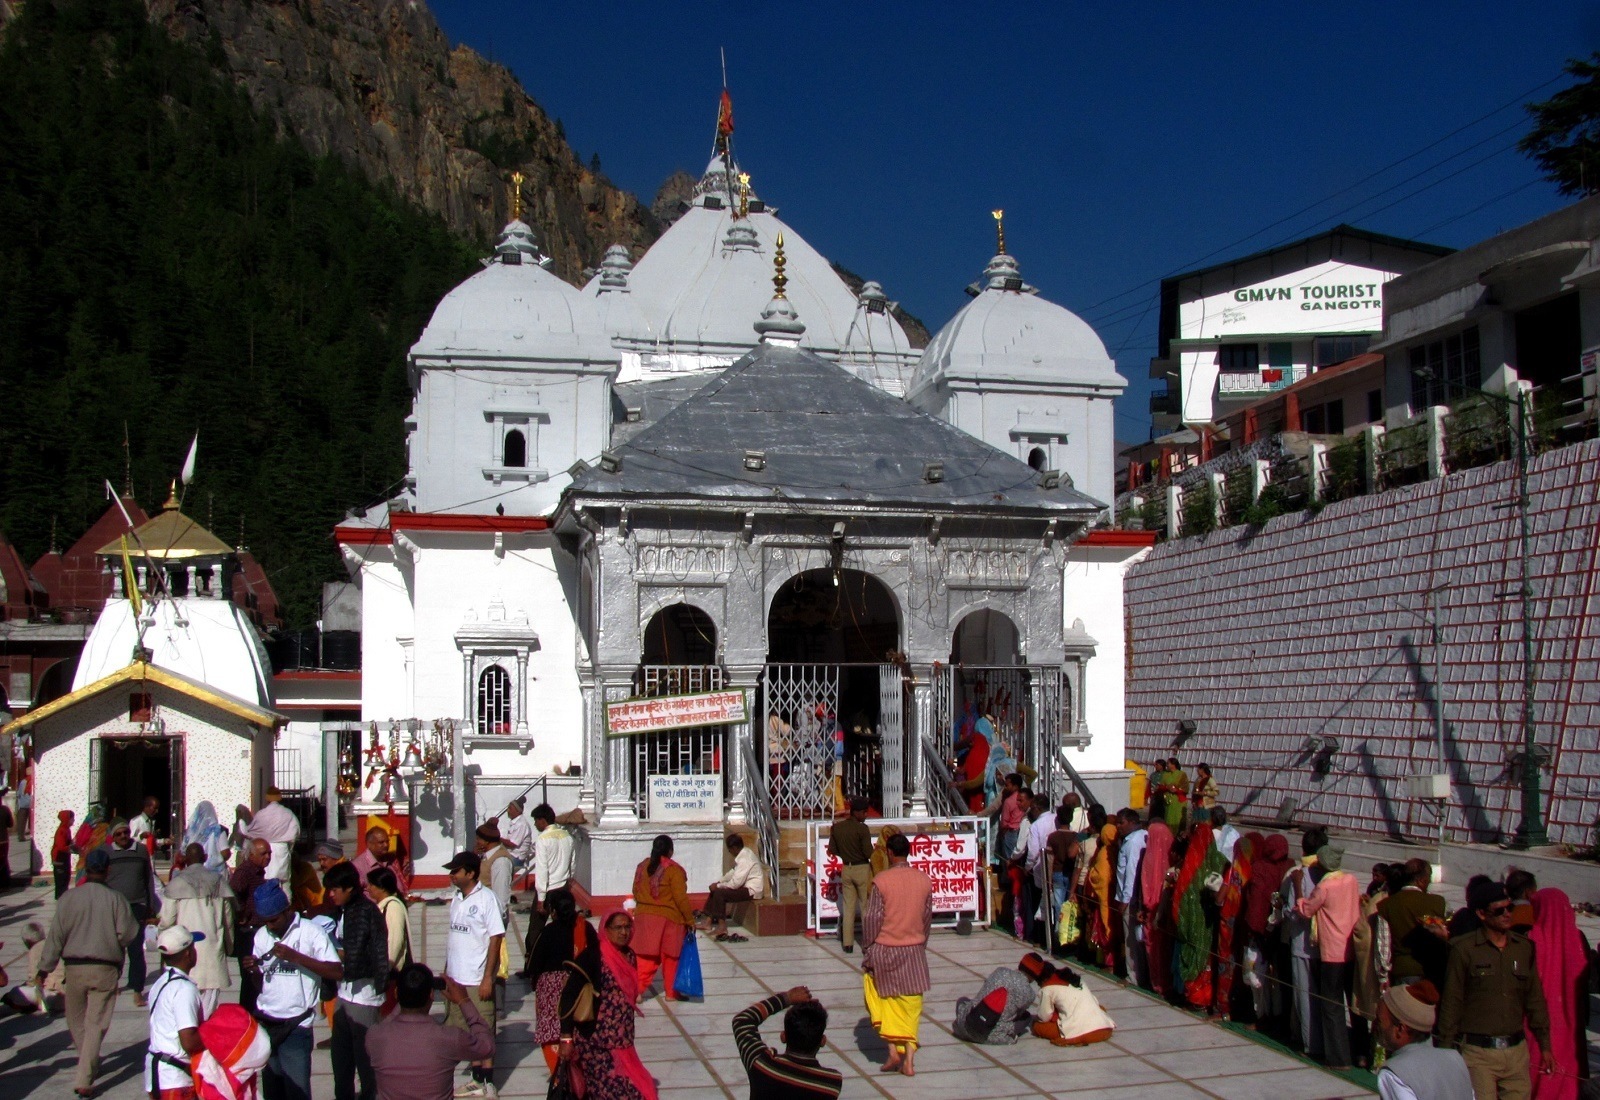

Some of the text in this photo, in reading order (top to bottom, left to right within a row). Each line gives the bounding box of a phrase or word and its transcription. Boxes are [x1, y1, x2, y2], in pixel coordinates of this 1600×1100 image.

[1234, 284, 1377, 302] GMVN TOURIST
[706, 695, 722, 708] फोटो
[654, 778, 670, 786] मंदिर
[672, 778, 679, 786] के
[681, 778, 693, 786] गर्भ
[695, 780, 705, 788] गृह
[700, 790, 714, 798] लेना
[946, 834, 965, 854] के
[931, 860, 950, 876] तक
[941, 874, 948, 894] से
[950, 874, 974, 894] दर्शन
